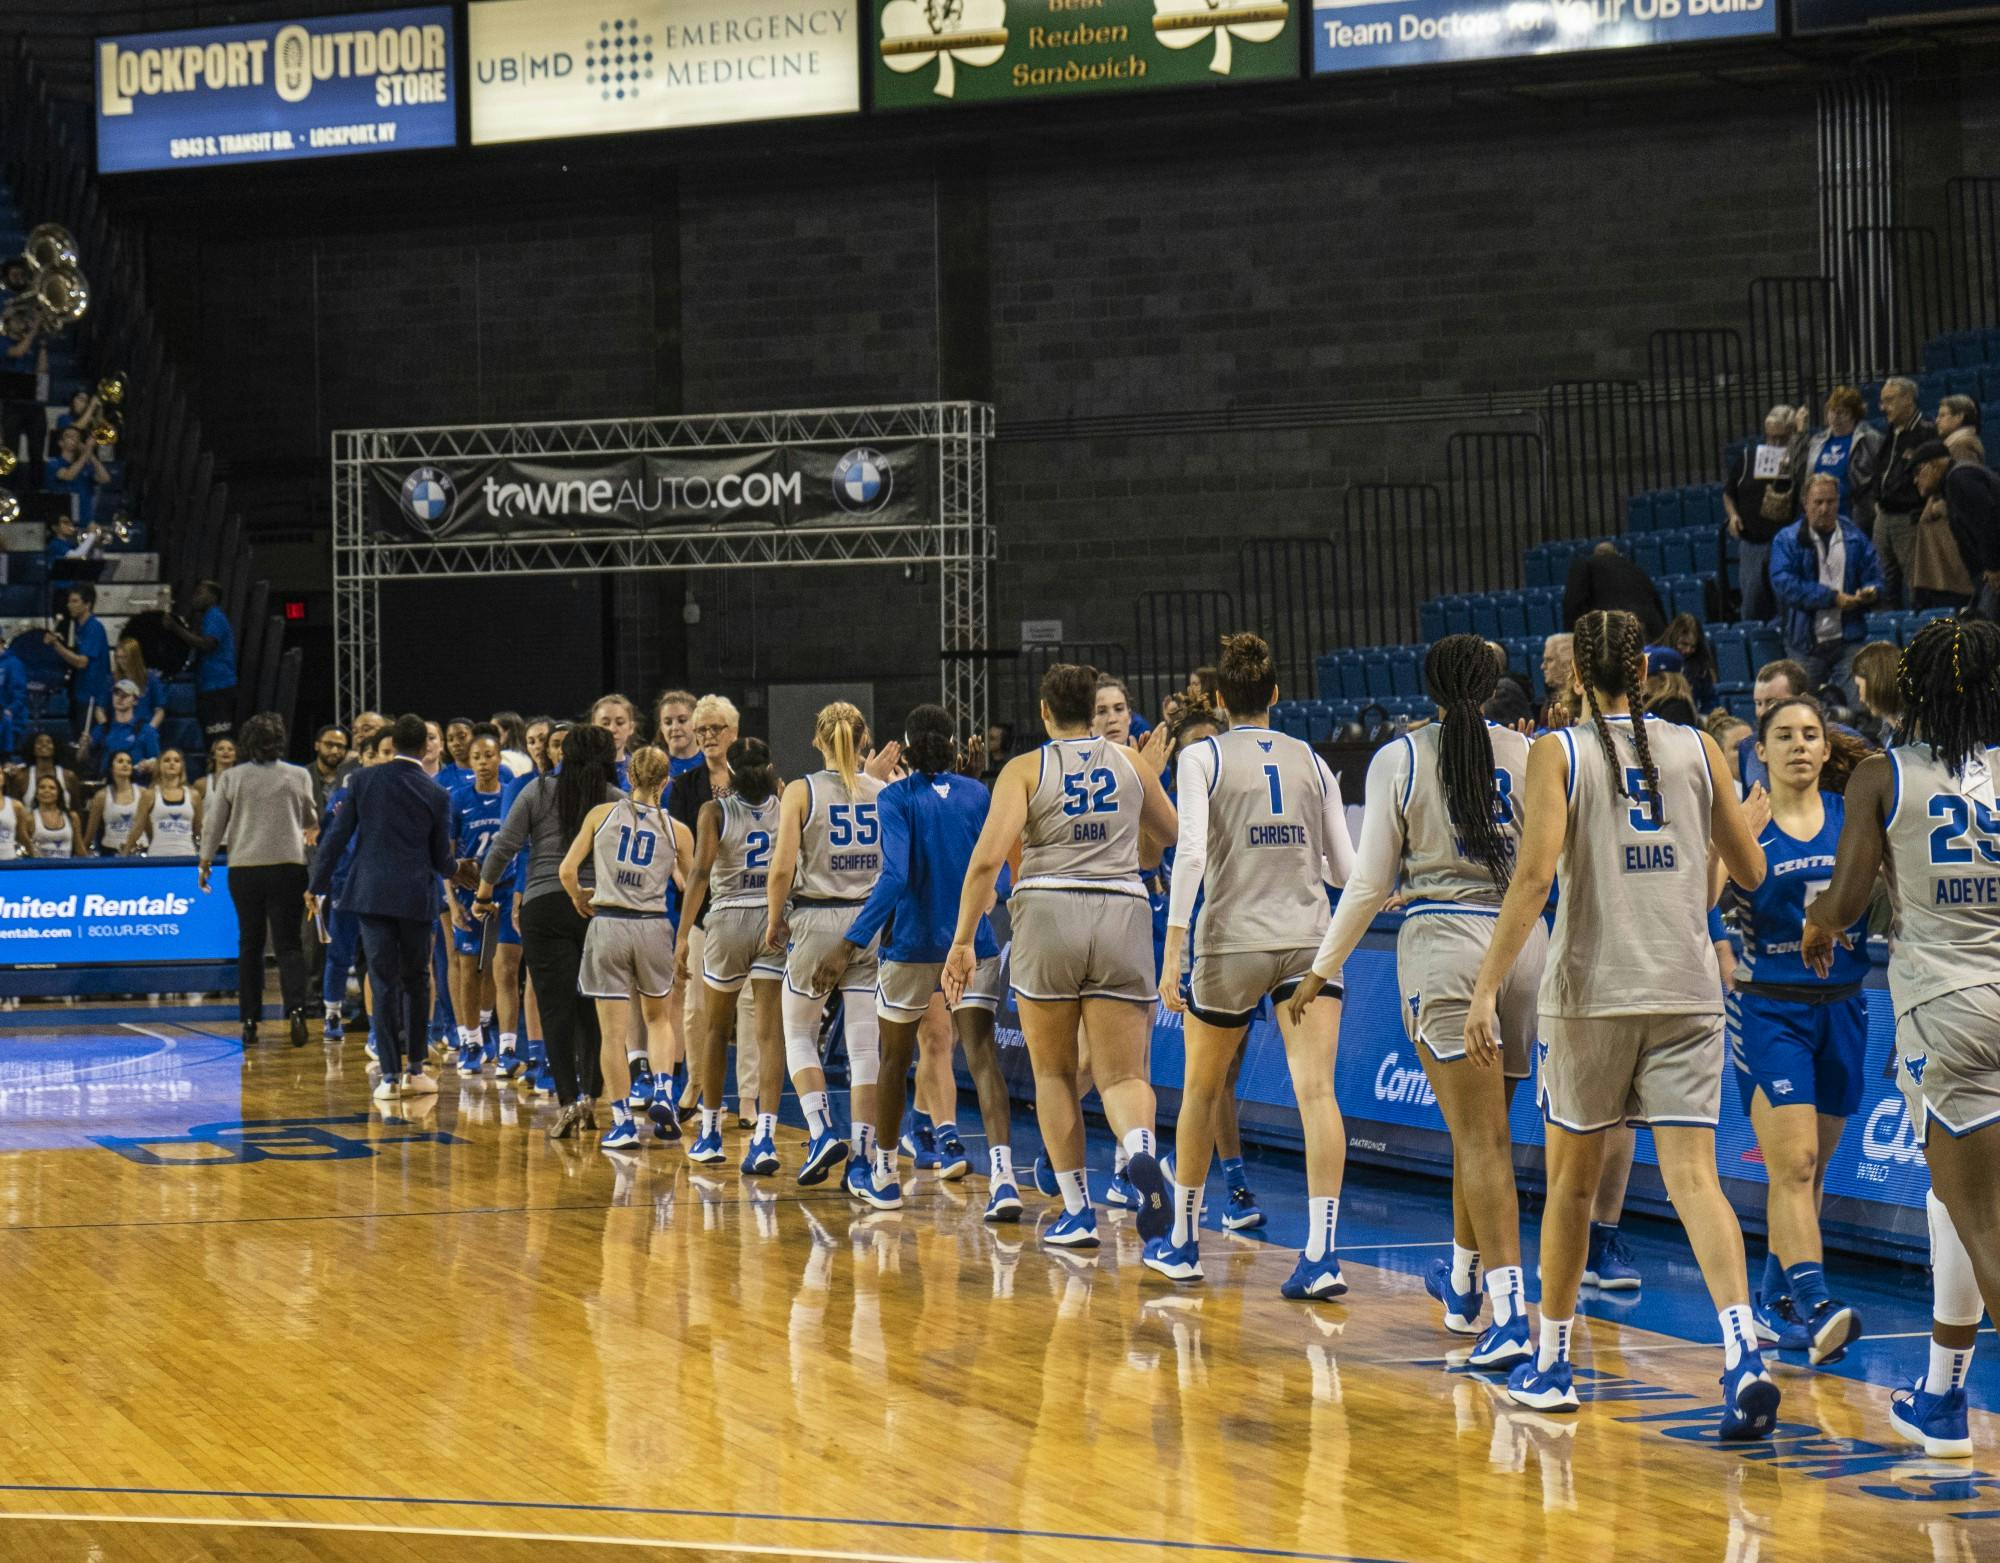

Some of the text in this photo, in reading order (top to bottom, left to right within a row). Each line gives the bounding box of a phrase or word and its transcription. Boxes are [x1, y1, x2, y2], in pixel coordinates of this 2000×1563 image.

[666, 9, 849, 49] EMERGENCY
[1028, 23, 1128, 49] Reuben
[1323, 20, 1393, 49] Team
[1400, 12, 1500, 42] Doctors
[102, 24, 446, 116] LOCKPORT OUTDOOR
[666, 51, 821, 87] MEDICINE
[1012, 54, 1147, 87] Sandwich
[375, 72, 446, 108] STORE
[219, 132, 271, 155] TRANSIT
[1062, 767, 1120, 817] 52
[1262, 763, 1285, 816] 1
[1624, 766, 1665, 833] 5
[828, 803, 879, 848] 55
[1074, 823, 1107, 841] GABA
[1250, 825, 1306, 845] CHRISTIE
[616, 823, 656, 868] 10
[745, 830, 772, 869] 2
[831, 854, 878, 872] SCHIFFER
[1625, 845, 1675, 870] ELIAS
[617, 871, 642, 887] HALL
[1936, 877, 2000, 905] ADEYE
[0, 892, 190, 919] nited Rentals
